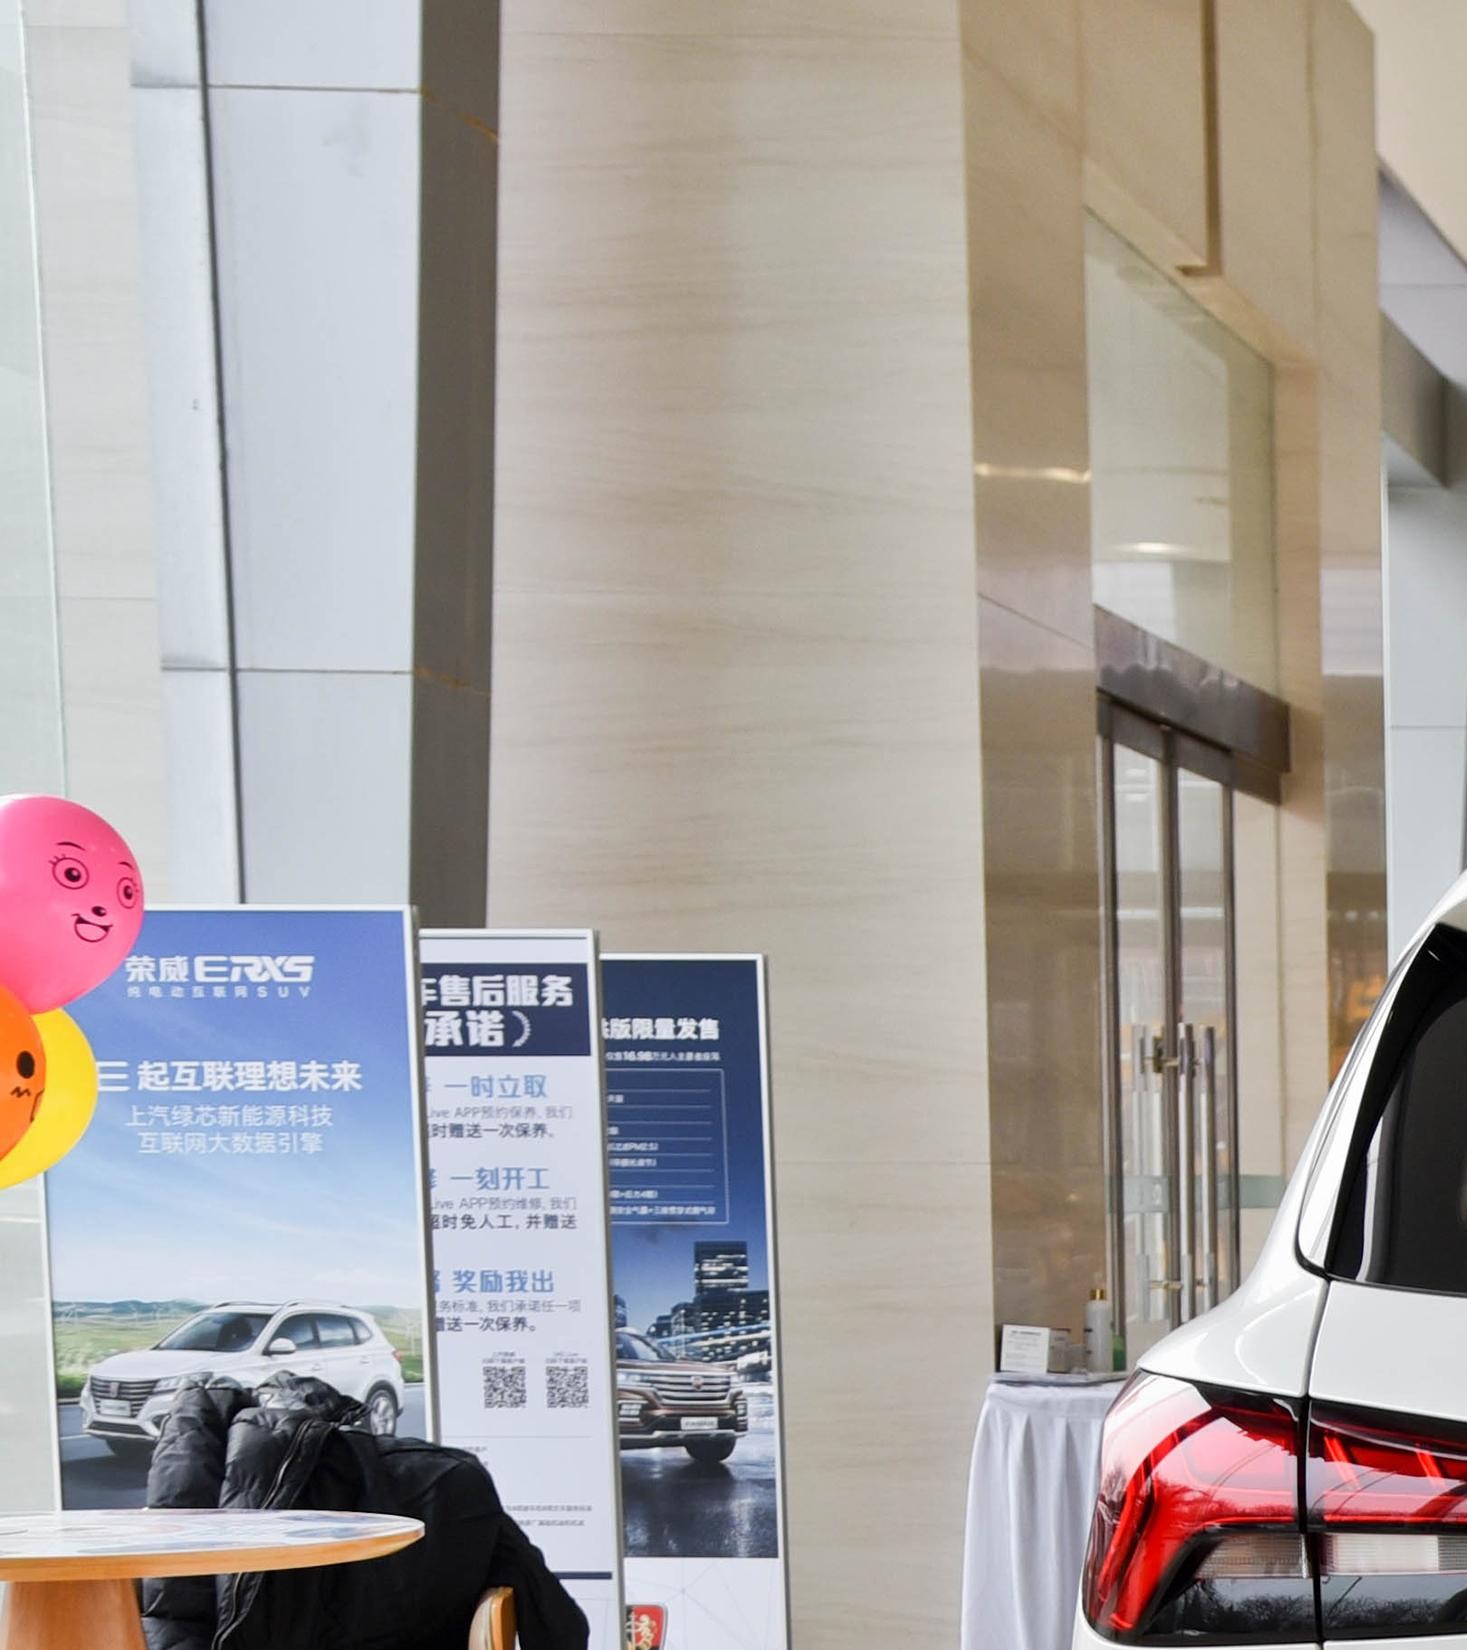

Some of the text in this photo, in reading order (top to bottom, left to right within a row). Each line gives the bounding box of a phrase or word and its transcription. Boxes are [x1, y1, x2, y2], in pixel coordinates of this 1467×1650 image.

[444, 1075, 547, 1098] 一时立取
[125, 1105, 333, 1127] 上汽绿芯新能源科技
[138, 1132, 323, 1153] 互联网大数据引擎
[450, 1167, 550, 1191] 一刻开工
[453, 1270, 554, 1293] 奖励我出
